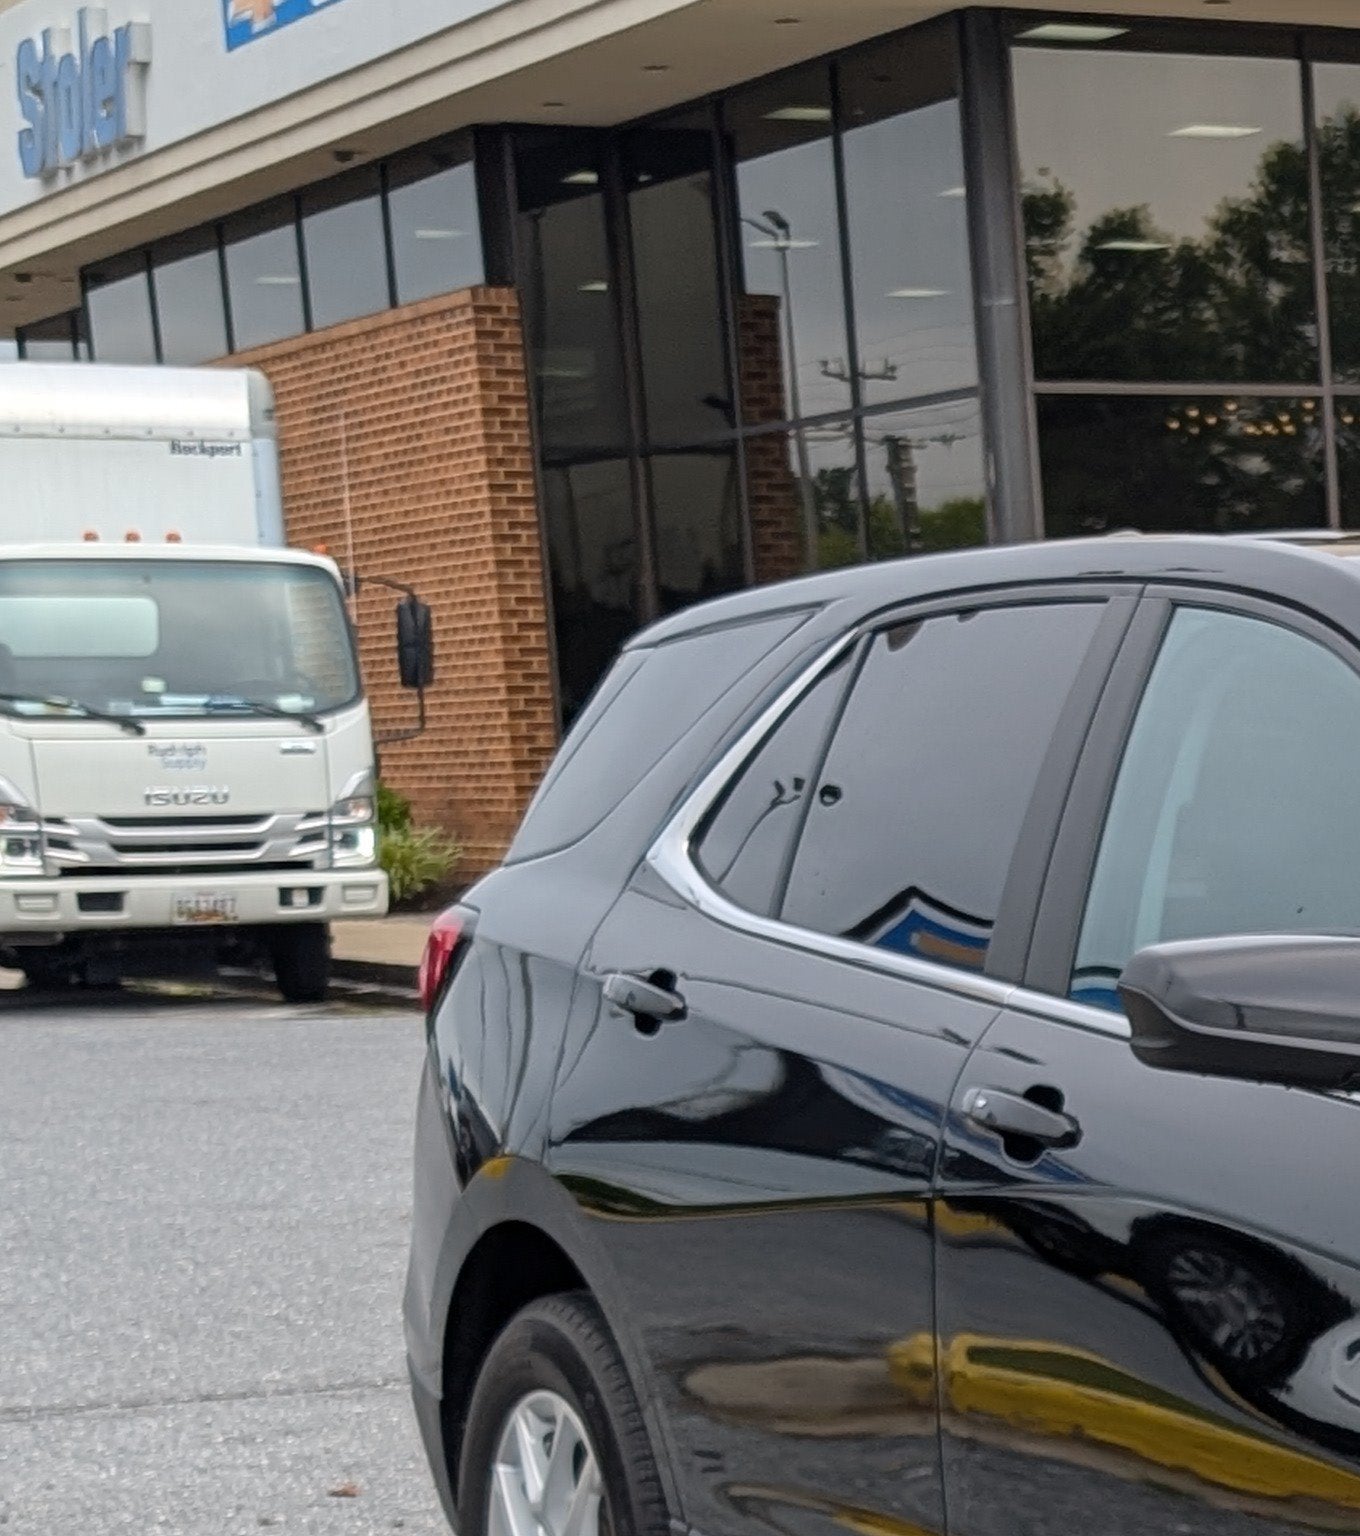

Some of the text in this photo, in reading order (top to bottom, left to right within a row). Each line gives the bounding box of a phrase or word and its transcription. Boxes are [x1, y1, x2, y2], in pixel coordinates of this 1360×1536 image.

[17, 7, 151, 179] Stoler
[170, 439, 242, 458] Rockport
[144, 785, 230, 806] ISUZU
